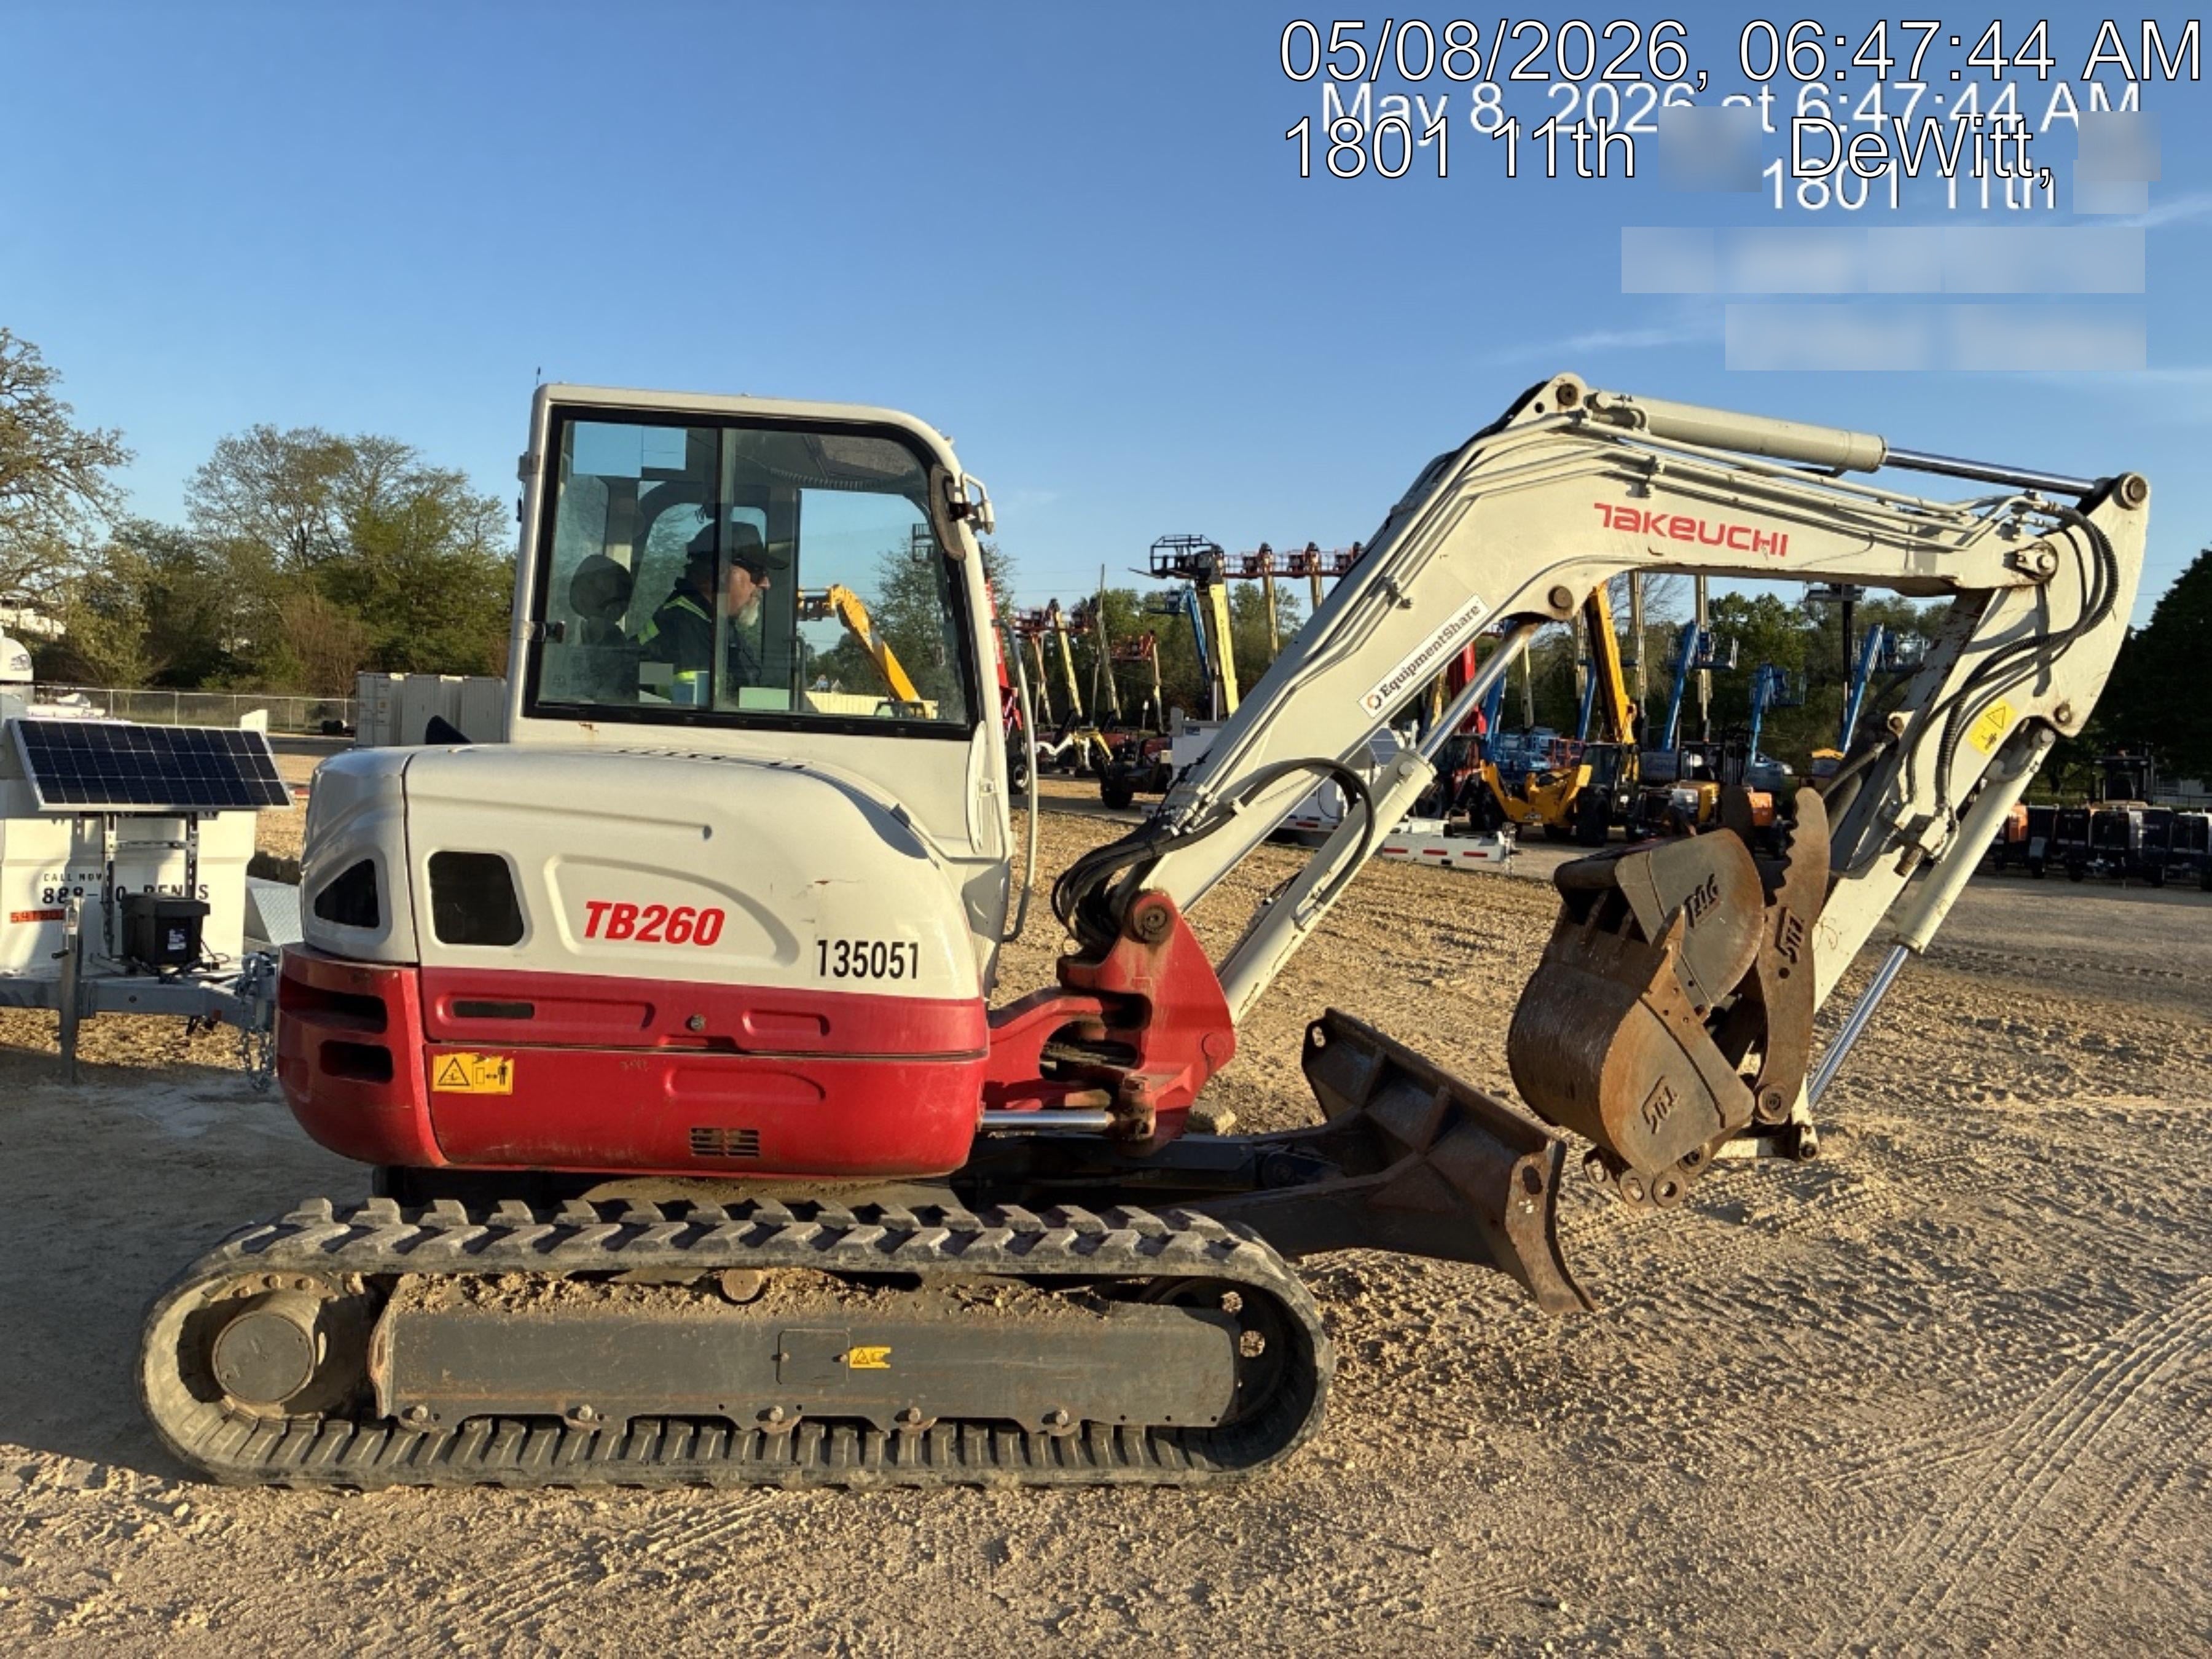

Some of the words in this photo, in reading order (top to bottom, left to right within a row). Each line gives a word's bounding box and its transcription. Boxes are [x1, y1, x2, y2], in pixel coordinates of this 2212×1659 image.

[1379, 605, 1481, 698] EquipmentShare
[584, 901, 726, 946] TB260
[817, 939, 919, 979] 135051
